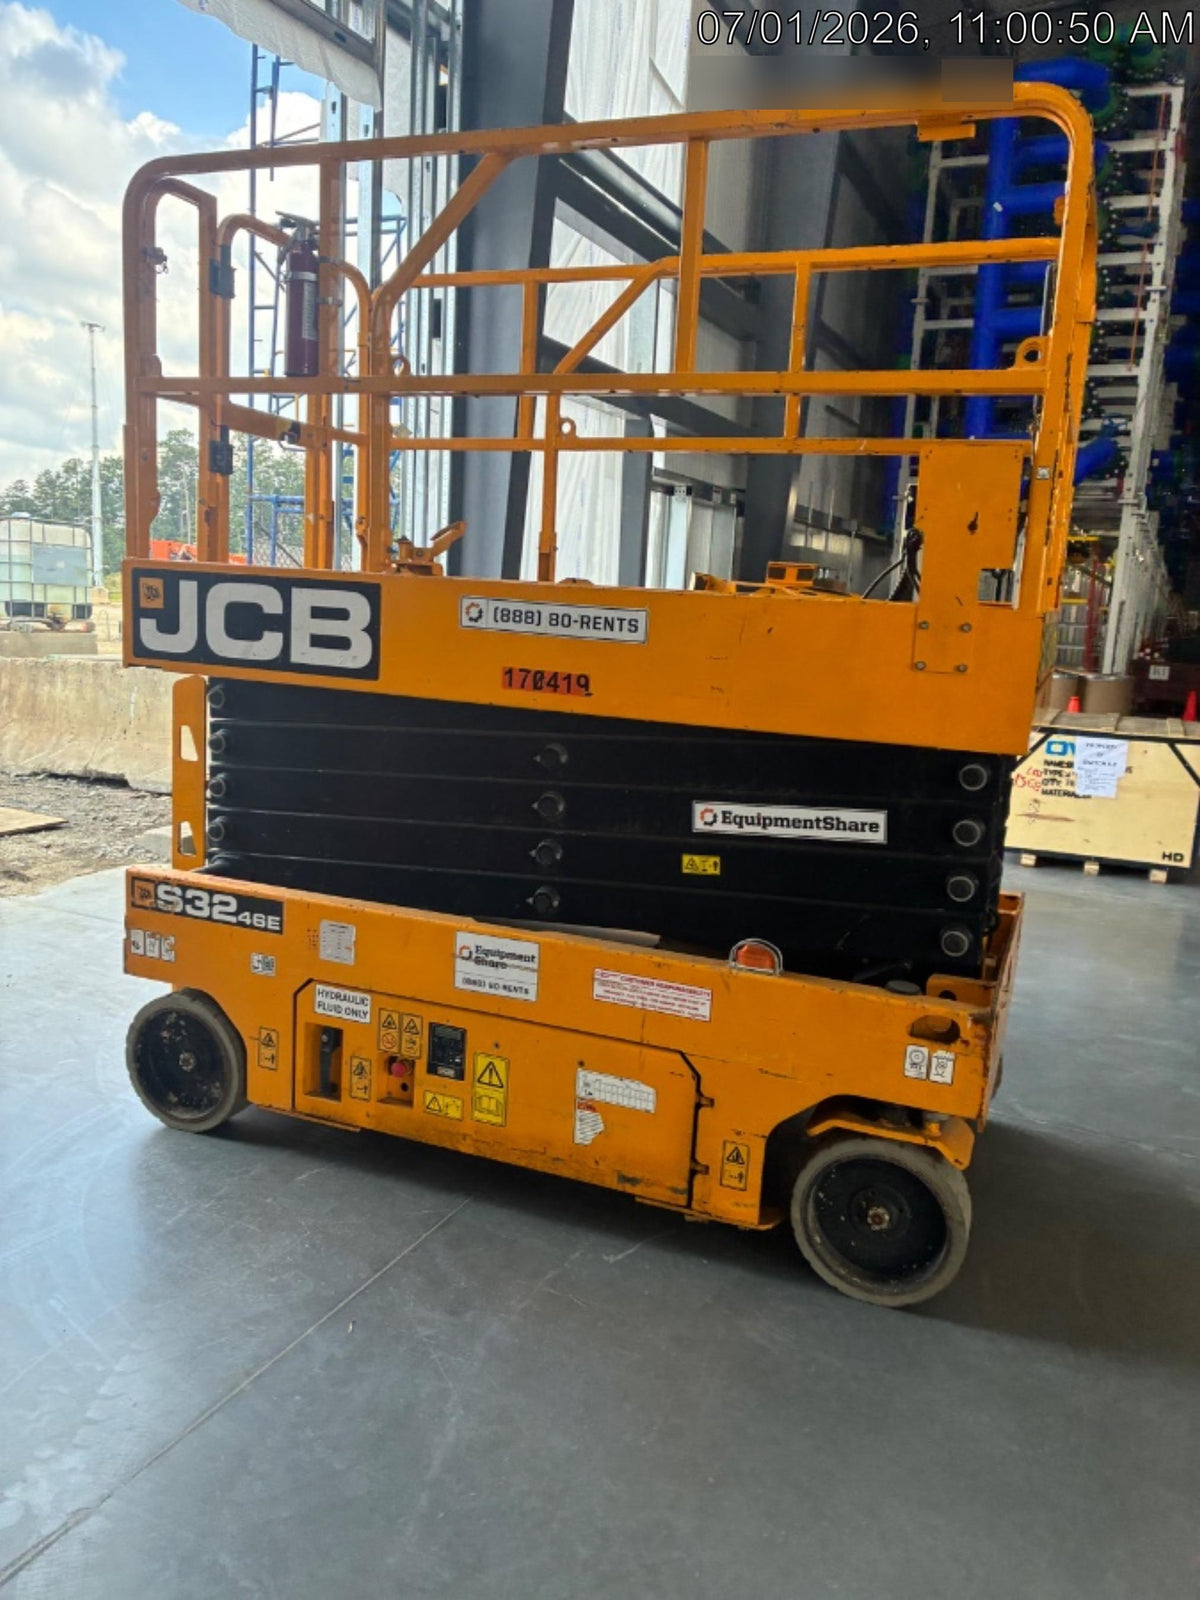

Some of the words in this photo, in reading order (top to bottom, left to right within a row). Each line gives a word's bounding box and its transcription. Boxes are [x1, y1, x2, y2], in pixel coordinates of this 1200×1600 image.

[138, 579, 373, 670] JCB
[493, 606, 542, 627] (888)
[548, 612, 639, 634] 80-RENTS
[720, 810, 880, 833] EquipmentShare
[1162, 850, 1184, 863] HD
[317, 988, 369, 1007] HYDRAULIC
[317, 1000, 343, 1014] FLUID
[344, 1006, 369, 1020] ONLY
